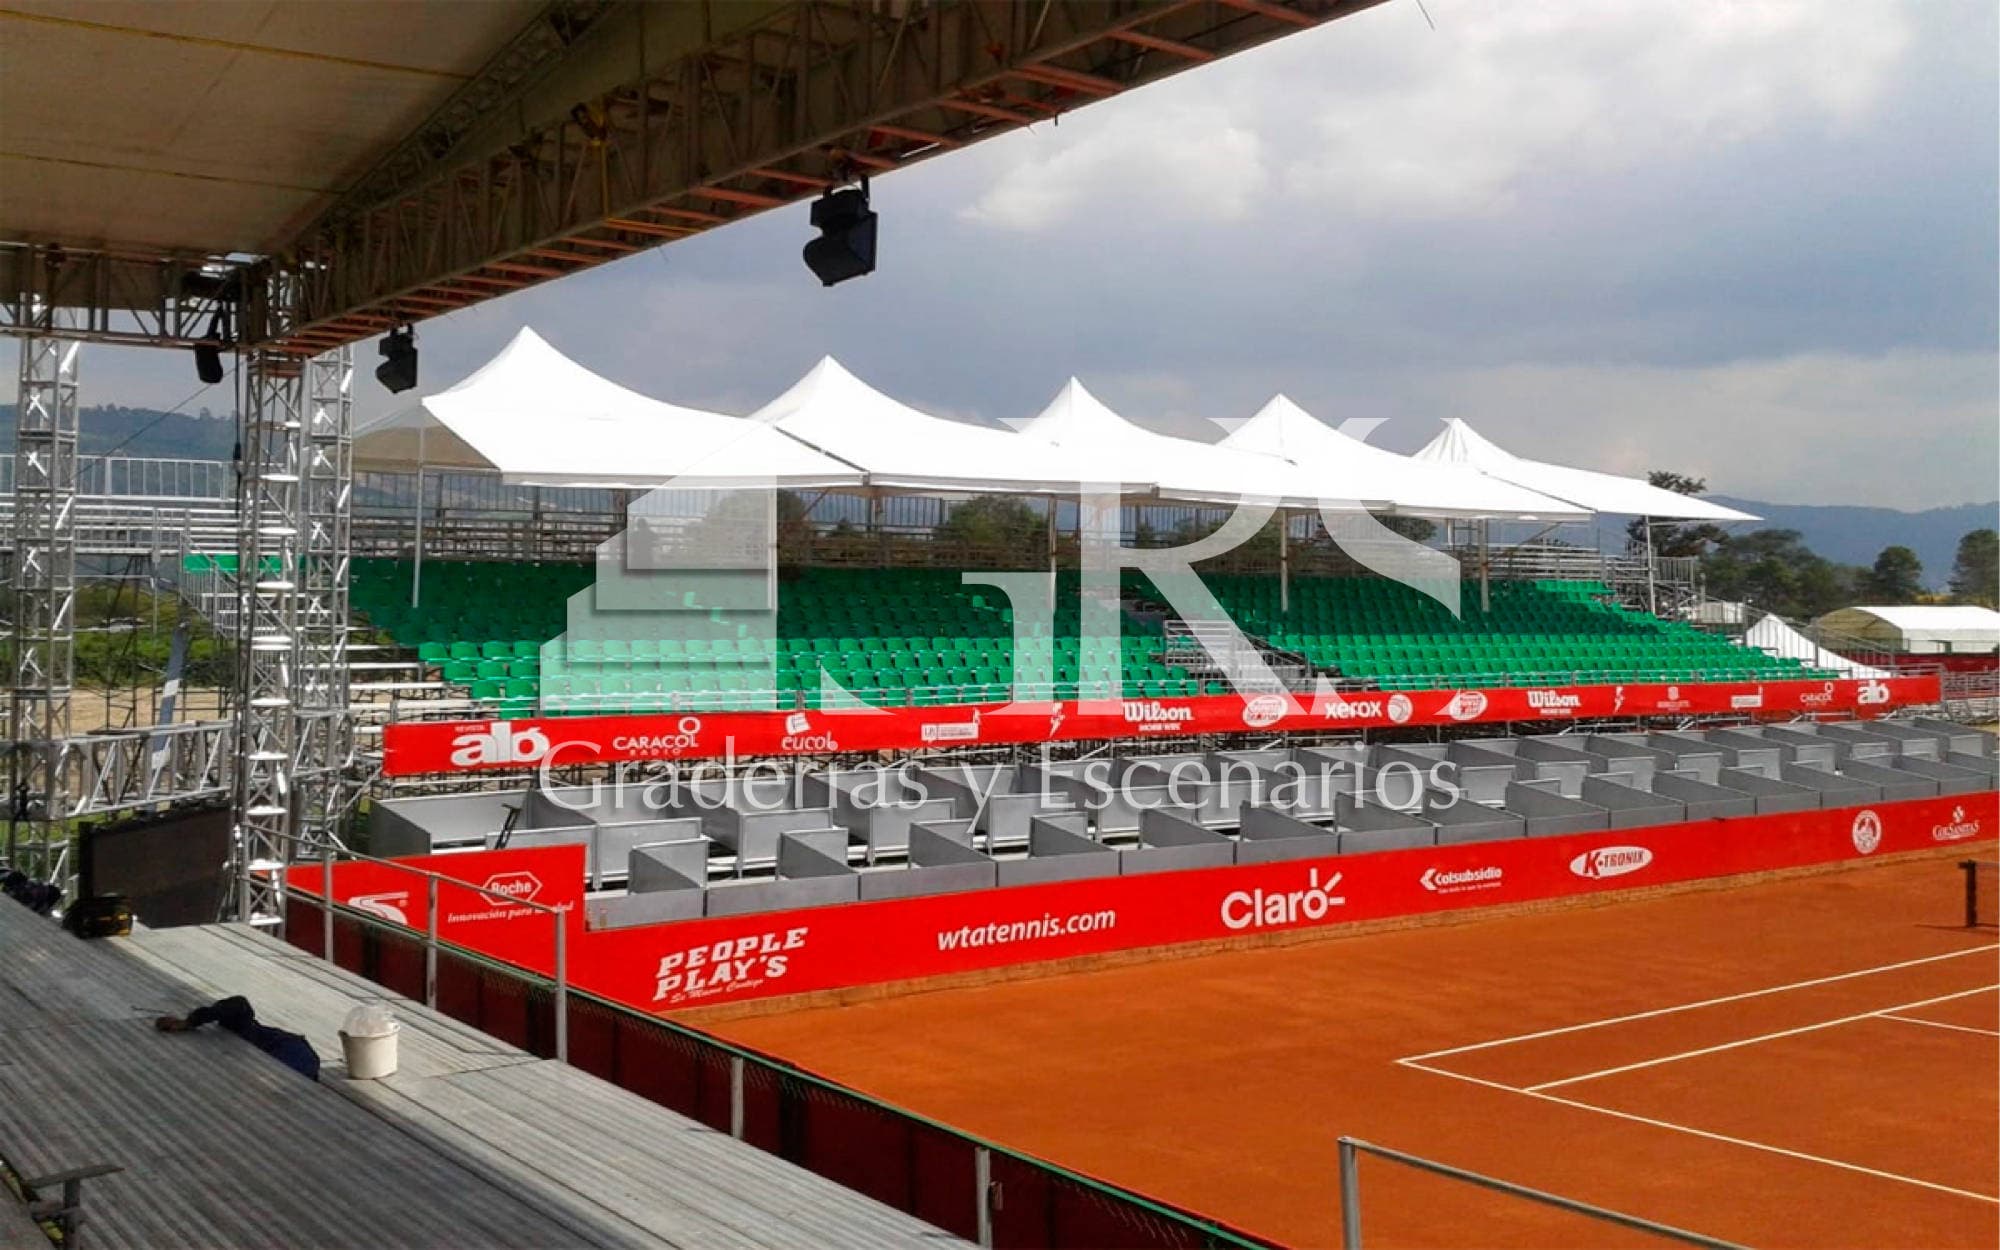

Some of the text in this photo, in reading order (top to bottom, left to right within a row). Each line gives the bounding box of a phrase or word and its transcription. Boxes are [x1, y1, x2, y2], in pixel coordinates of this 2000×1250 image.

[1528, 690, 1582, 708] Wilson
[1123, 702, 1195, 721] Wilson
[1325, 700, 1381, 719] xerox
[613, 734, 699, 751] CARACOL
[629, 748, 681, 756] RADIO
[1435, 867, 1502, 885] Colsubsidio
[491, 880, 532, 897] Roche
[508, 907, 533, 920] para
[1220, 887, 1329, 930] Claro
[937, 909, 1116, 951] wtatennis.com
[656, 927, 809, 978] PEOPLE
[652, 955, 788, 1001] PLAY'S
